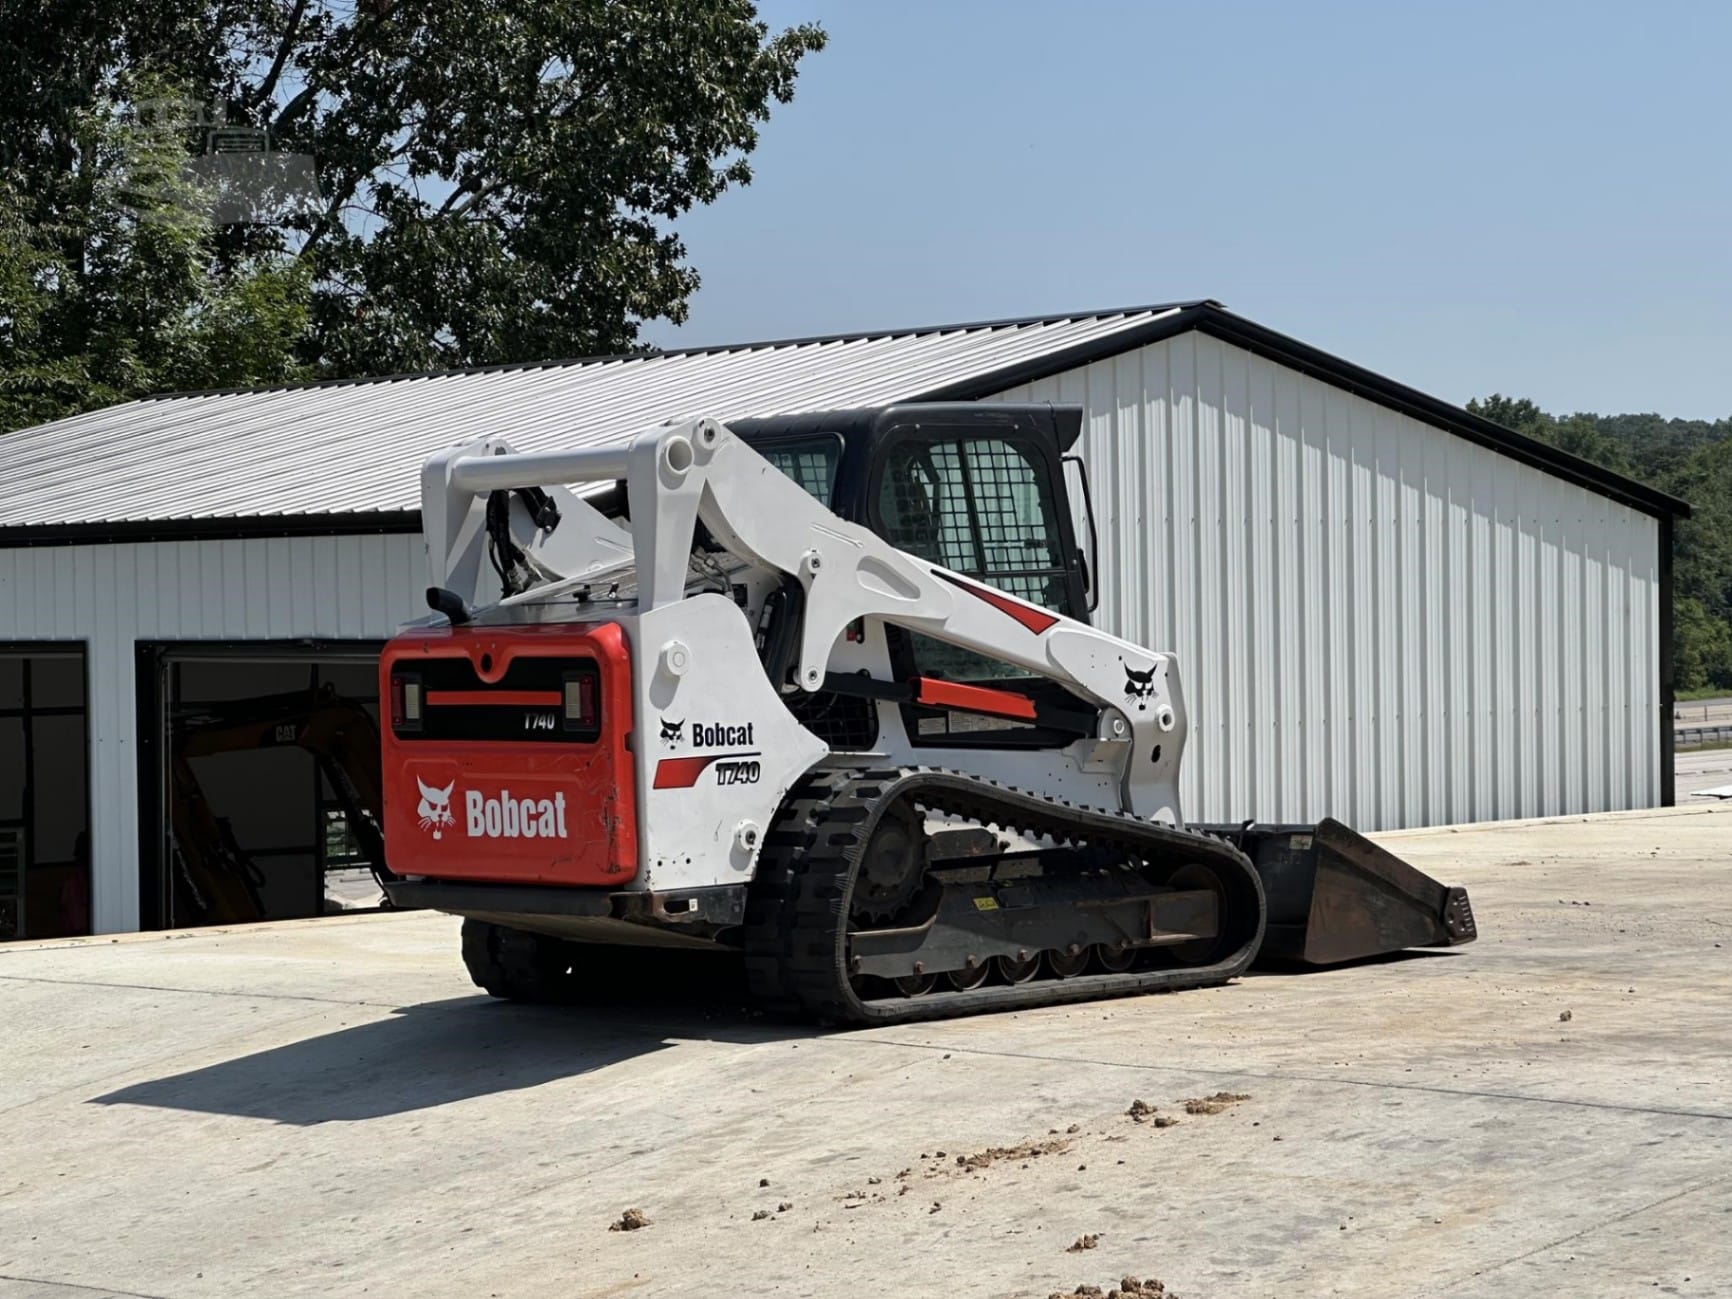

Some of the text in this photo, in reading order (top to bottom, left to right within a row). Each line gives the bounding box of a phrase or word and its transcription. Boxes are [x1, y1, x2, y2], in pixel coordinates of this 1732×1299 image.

[275, 724, 297, 742] CAT
[524, 713, 555, 730] T740
[692, 722, 754, 747] Bobcat
[715, 761, 761, 785] T740
[465, 789, 567, 839] Bobcat
